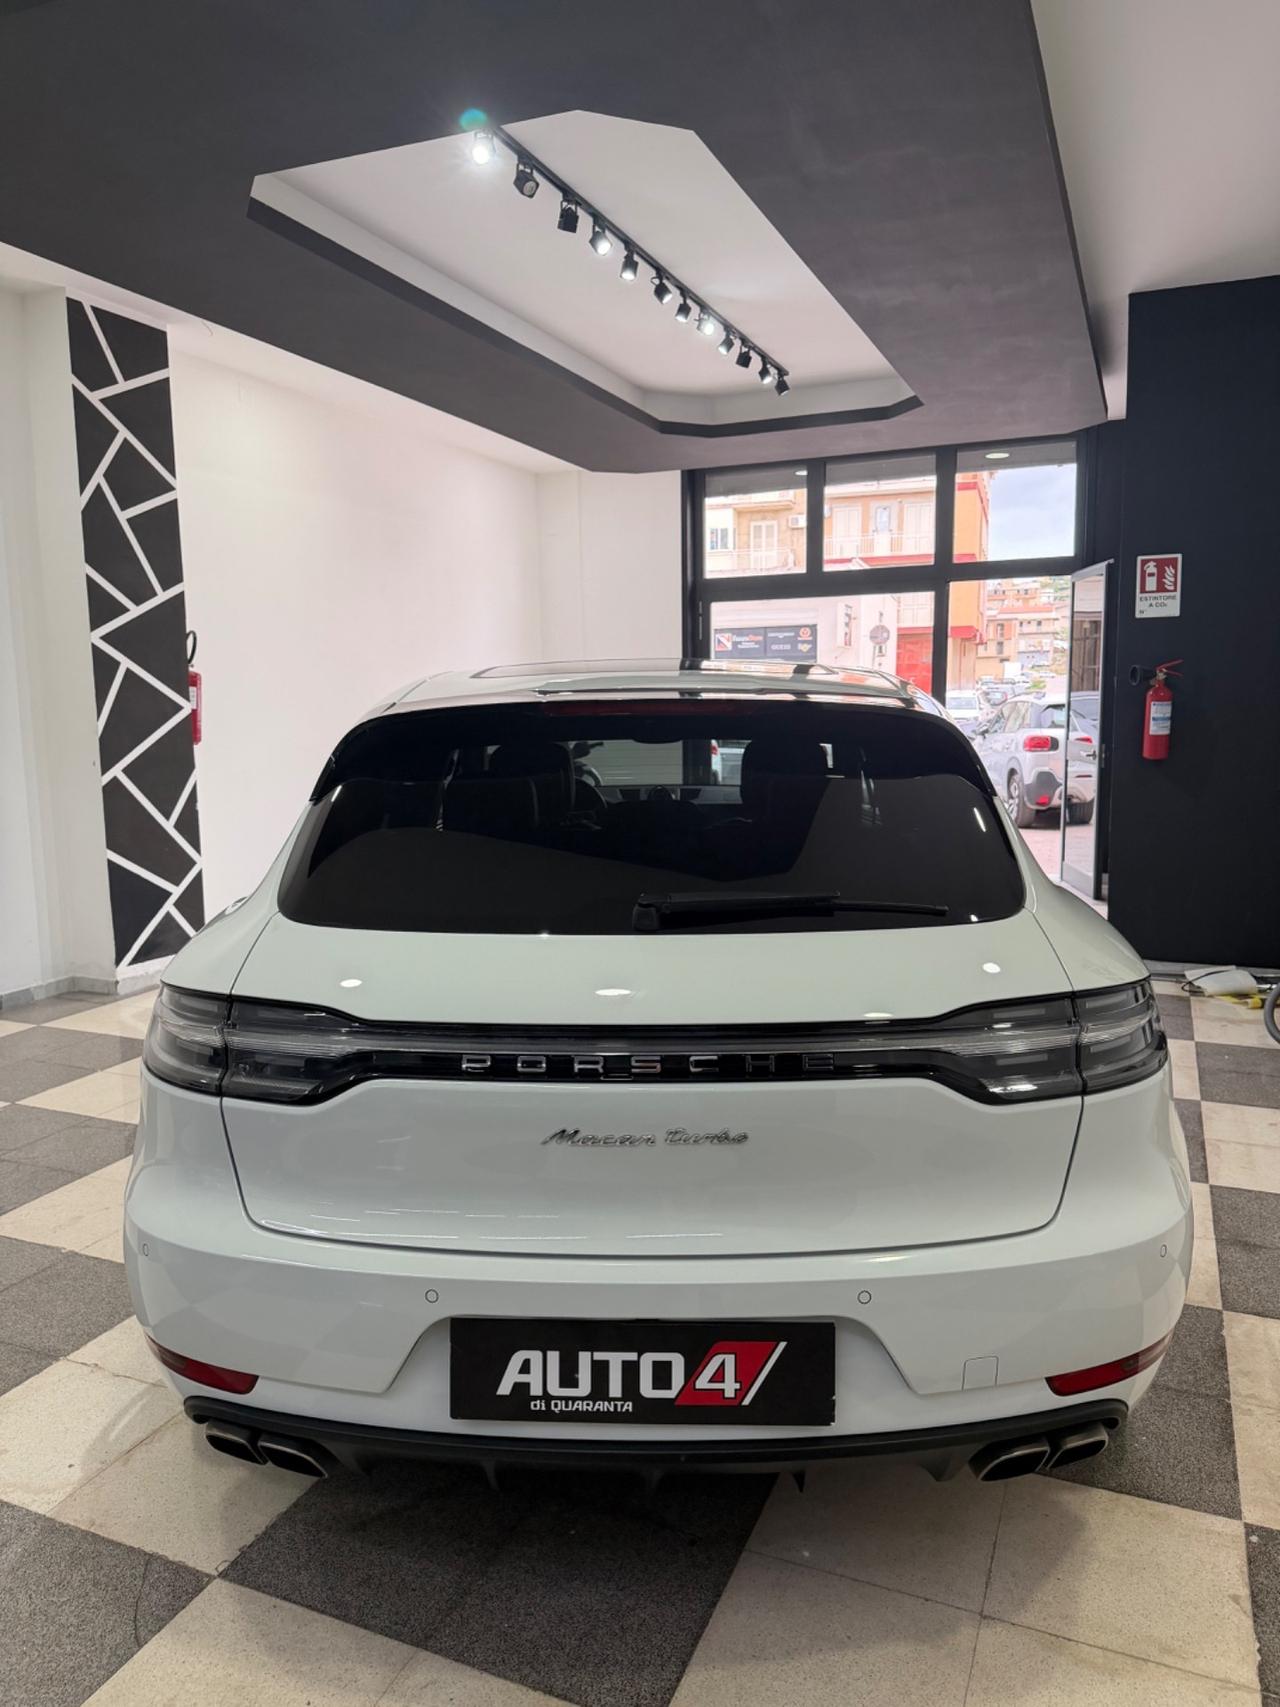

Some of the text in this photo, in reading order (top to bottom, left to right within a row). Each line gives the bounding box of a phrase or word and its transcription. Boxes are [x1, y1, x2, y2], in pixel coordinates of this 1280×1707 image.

[461, 1054, 834, 1073] PORSCHE
[542, 1128, 749, 1146] Macan Turbo
[530, 1399, 633, 1413] di QUARANTA
